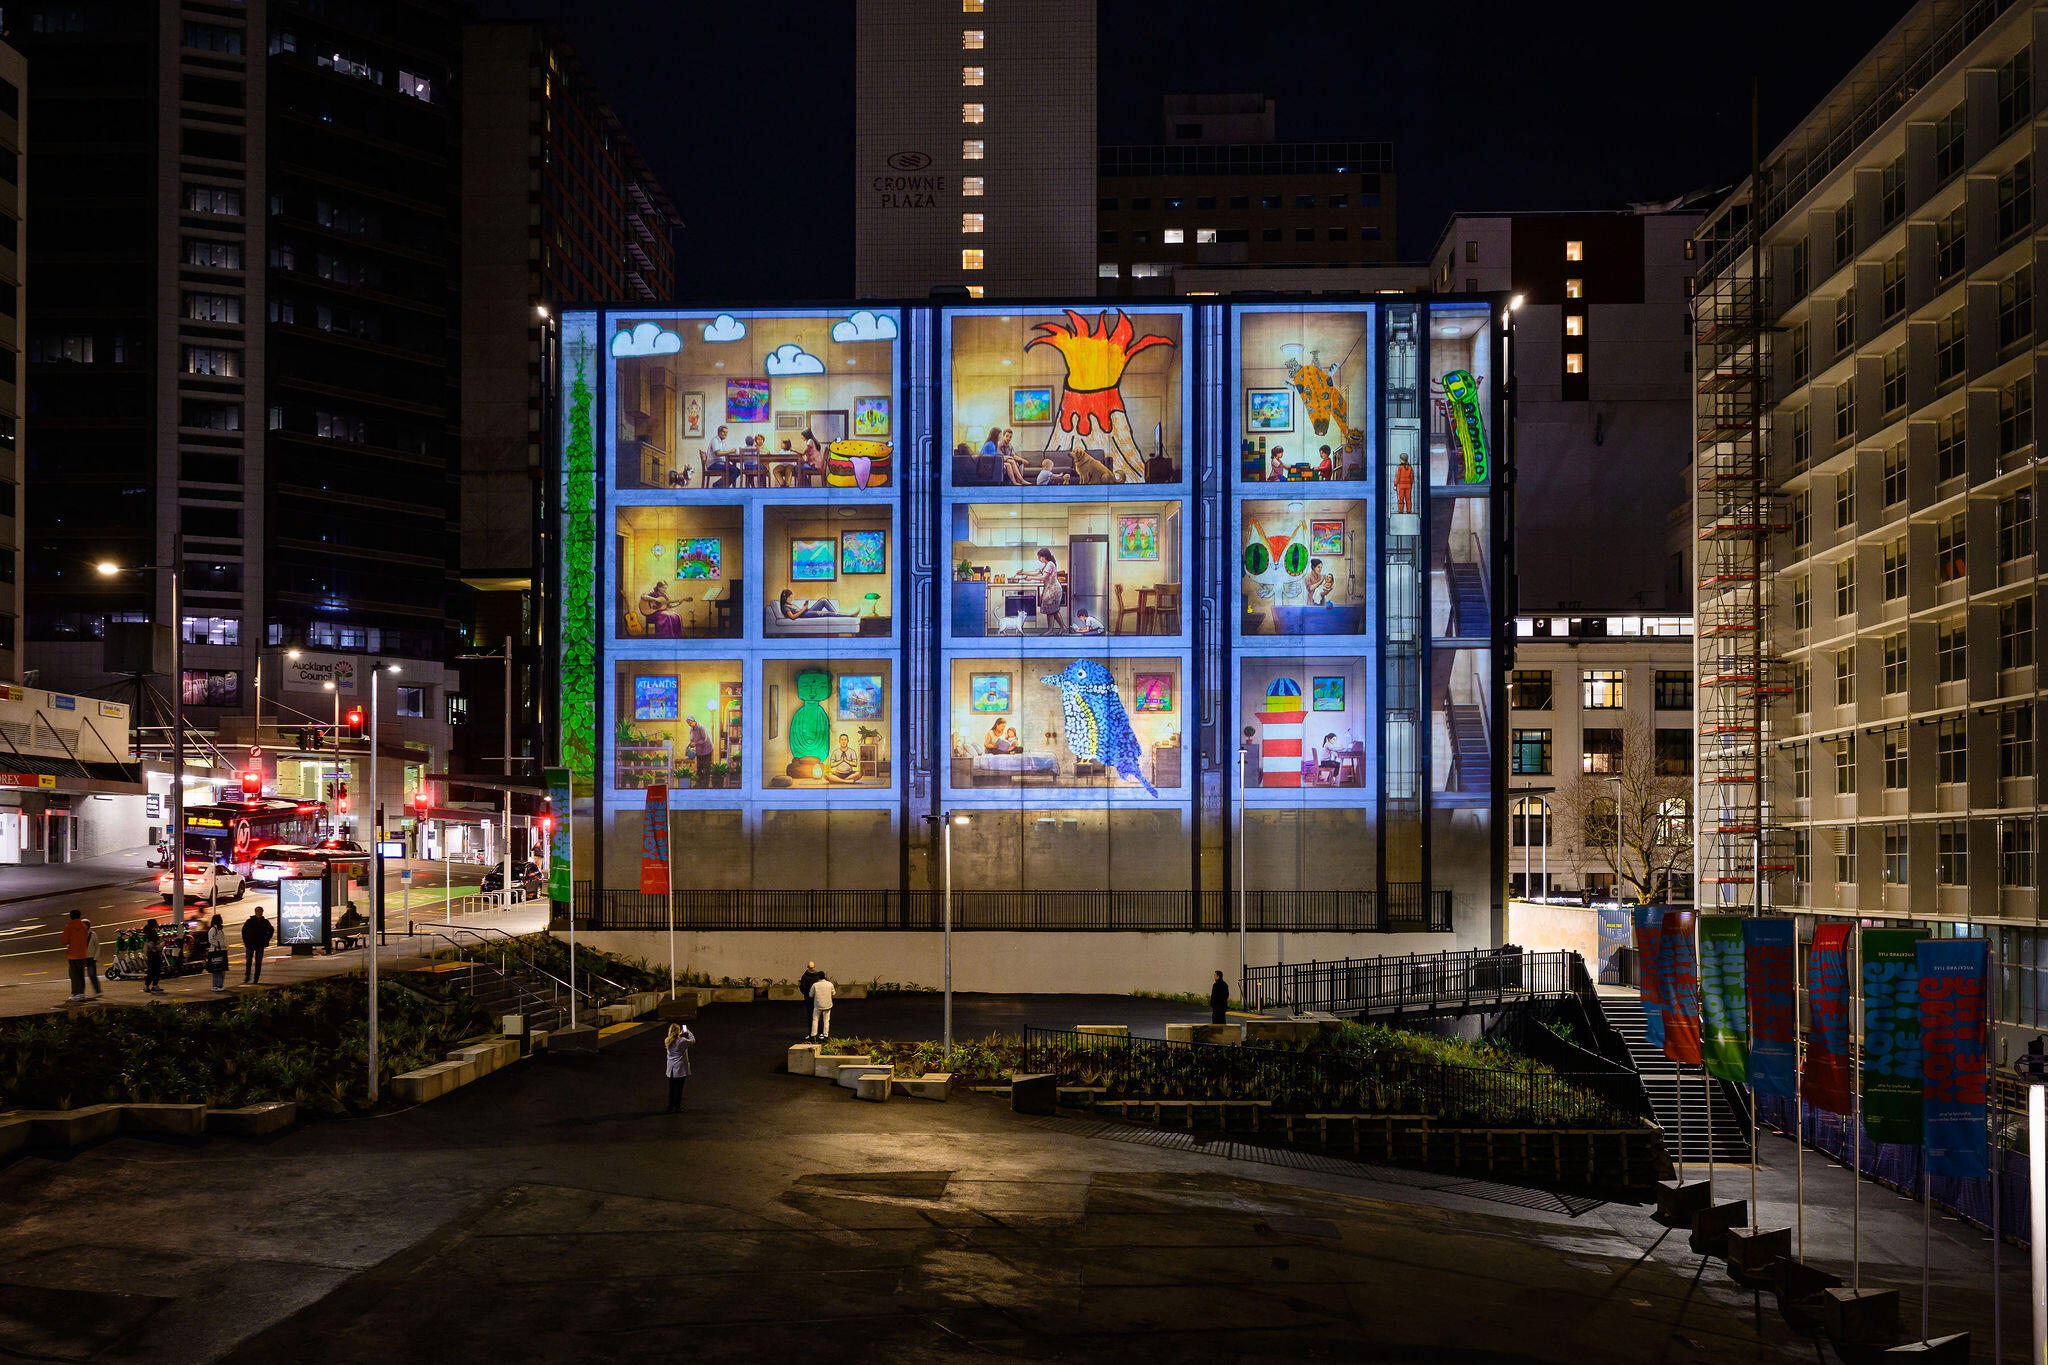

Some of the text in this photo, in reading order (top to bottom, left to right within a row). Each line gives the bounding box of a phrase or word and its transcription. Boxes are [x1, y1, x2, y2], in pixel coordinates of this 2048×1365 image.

[873, 176, 945, 191] CROWNE
[881, 194, 936, 208] PLAZA
[292, 661, 332, 672] Auckland
[300, 671, 332, 682] Council
[637, 680, 677, 689] ATLANTIS
[0, 774, 20, 785] REX
